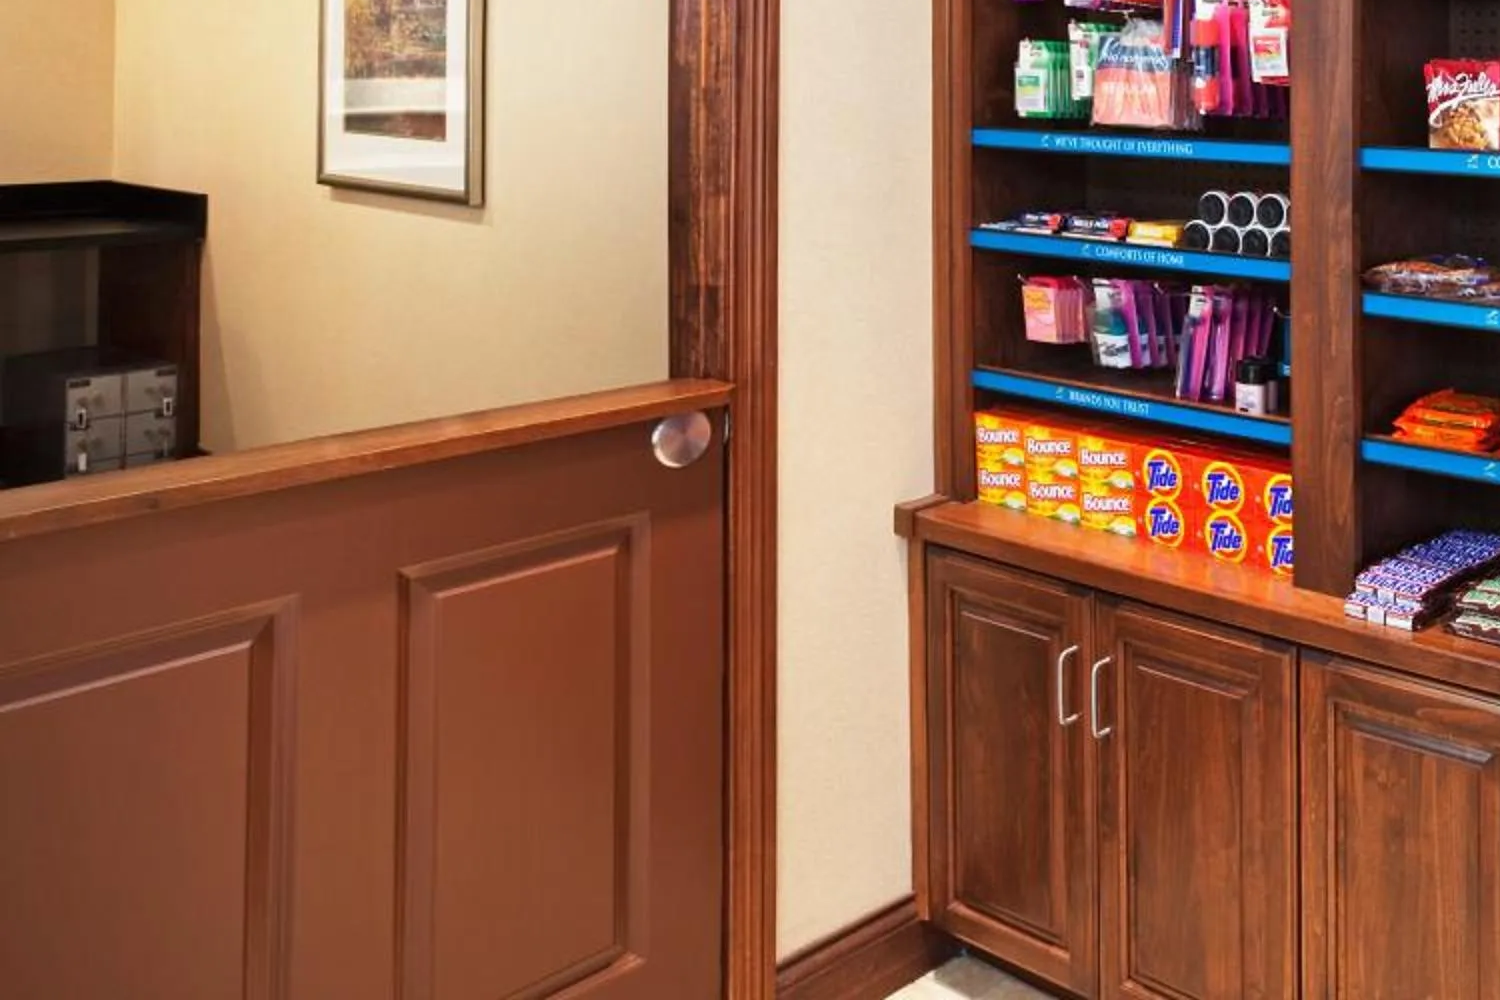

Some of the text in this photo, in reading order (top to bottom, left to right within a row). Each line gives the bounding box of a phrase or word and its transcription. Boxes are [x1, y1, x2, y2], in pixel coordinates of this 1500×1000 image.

[976, 426, 1021, 445] Bounce
[1027, 439, 1072, 456] Bounce
[1080, 448, 1128, 467] Bounce
[979, 469, 1022, 488] Bounce
[1147, 460, 1178, 491] Tide
[1029, 481, 1076, 501] Bounce
[1207, 473, 1241, 504] Tide
[1083, 492, 1131, 512] Bounce
[1149, 507, 1181, 538] Tide
[1209, 521, 1243, 552] Tide
